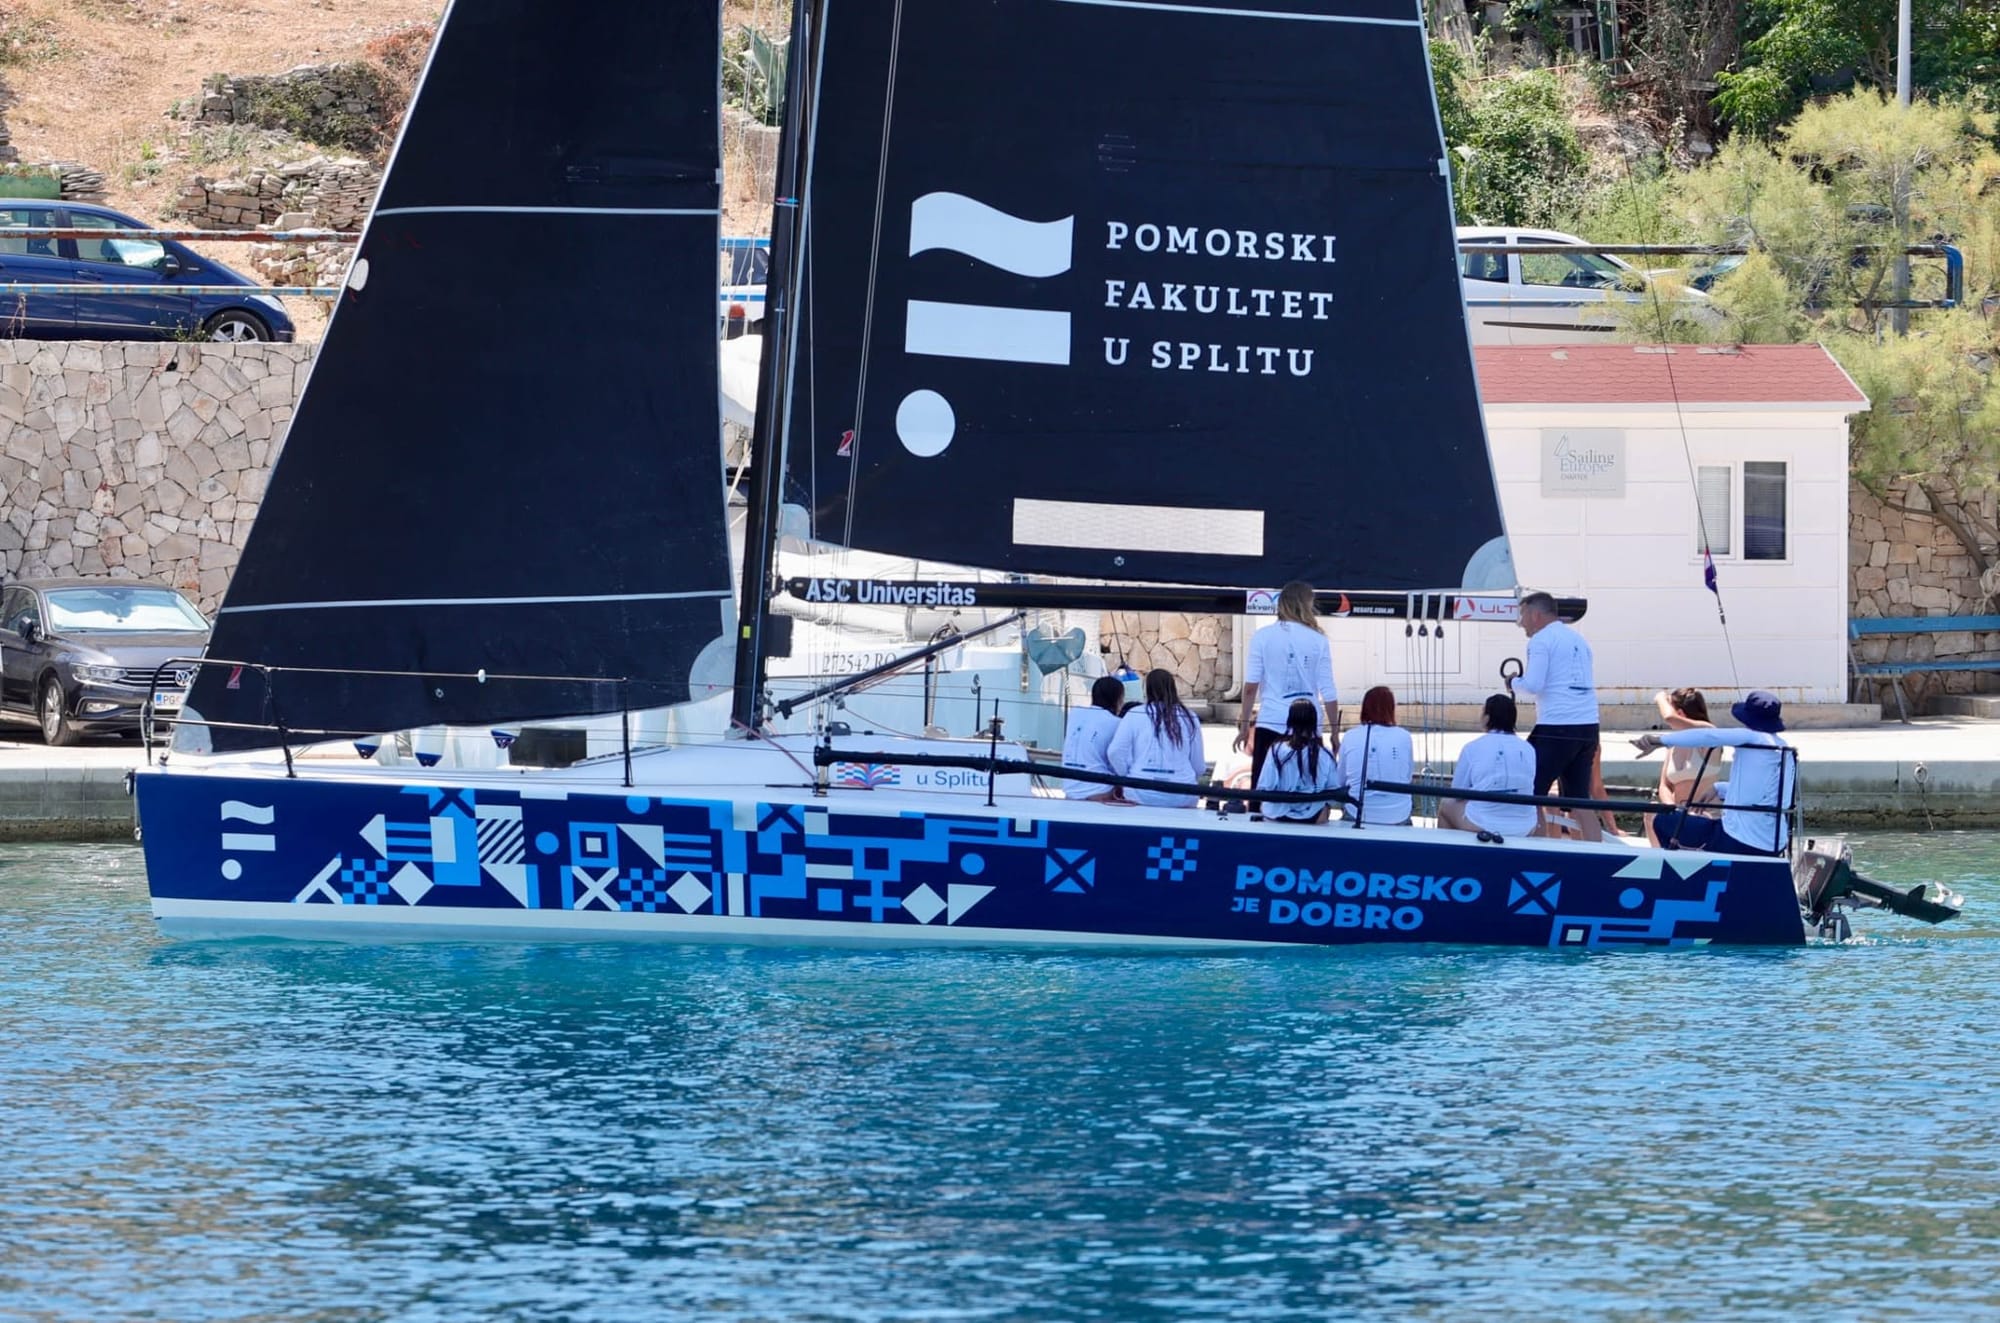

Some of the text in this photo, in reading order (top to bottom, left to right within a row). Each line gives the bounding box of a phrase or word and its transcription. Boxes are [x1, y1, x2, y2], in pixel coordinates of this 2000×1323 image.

[1106, 221, 1336, 263] POMORSKI
[1105, 279, 1333, 320] FAKULTET
[1103, 337, 1314, 376] U SPLITU
[1560, 458, 1609, 475] Europe
[1568, 449, 1615, 467] Sailing
[805, 578, 976, 605] ASC Universitas
[1480, 603, 1517, 613] ULT
[916, 769, 991, 789] u Splitu
[1235, 865, 1482, 903] POMORSKO
[1230, 897, 1424, 930] JE DOBRO
